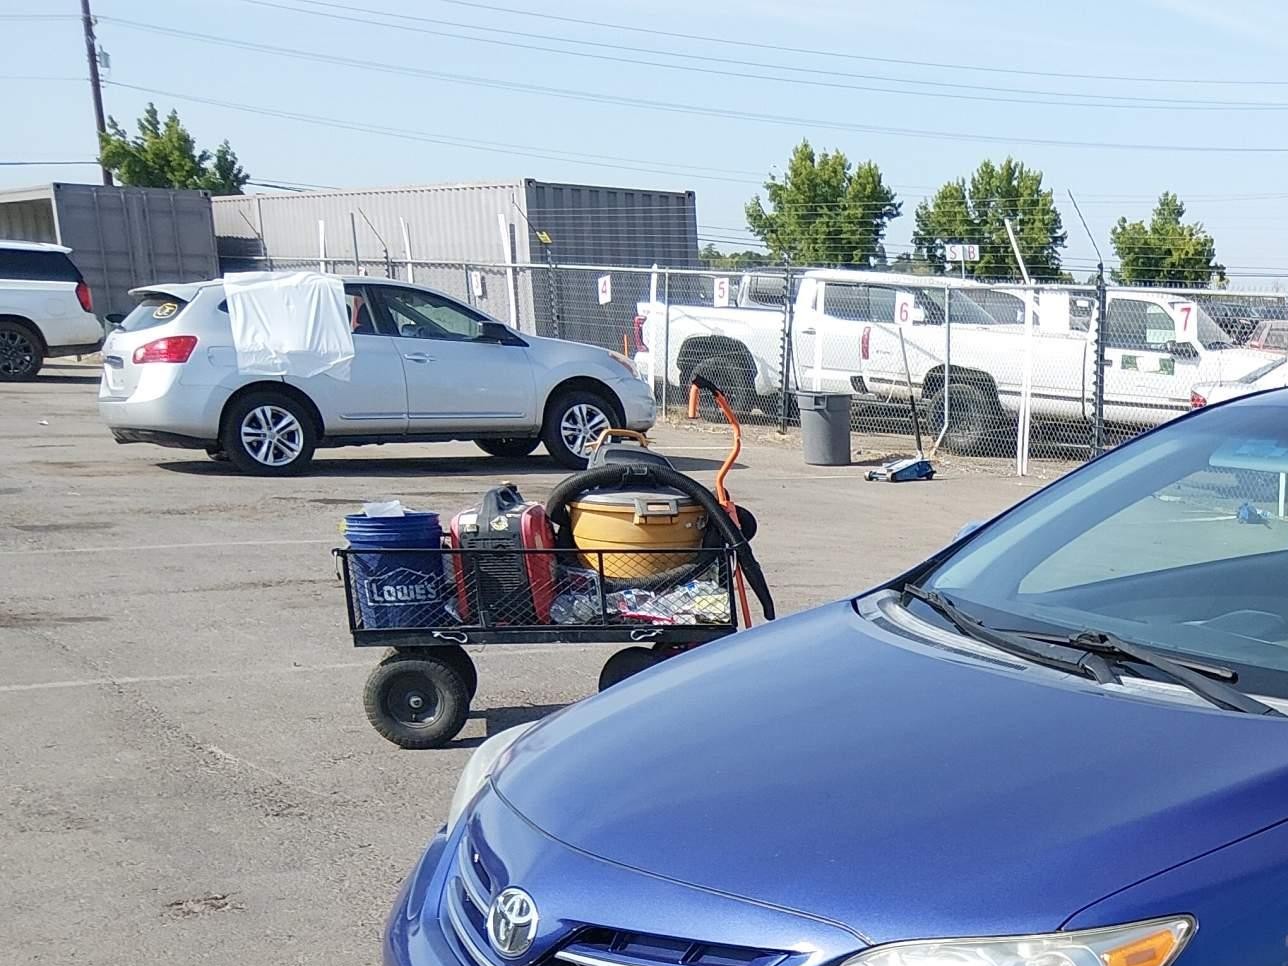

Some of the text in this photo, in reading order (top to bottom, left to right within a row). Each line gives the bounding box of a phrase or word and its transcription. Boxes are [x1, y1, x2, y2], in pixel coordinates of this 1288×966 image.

[968, 245, 976, 260] B
[718, 281, 725, 298] 5
[900, 302, 909, 321] 6
[1177, 307, 1191, 331] 7
